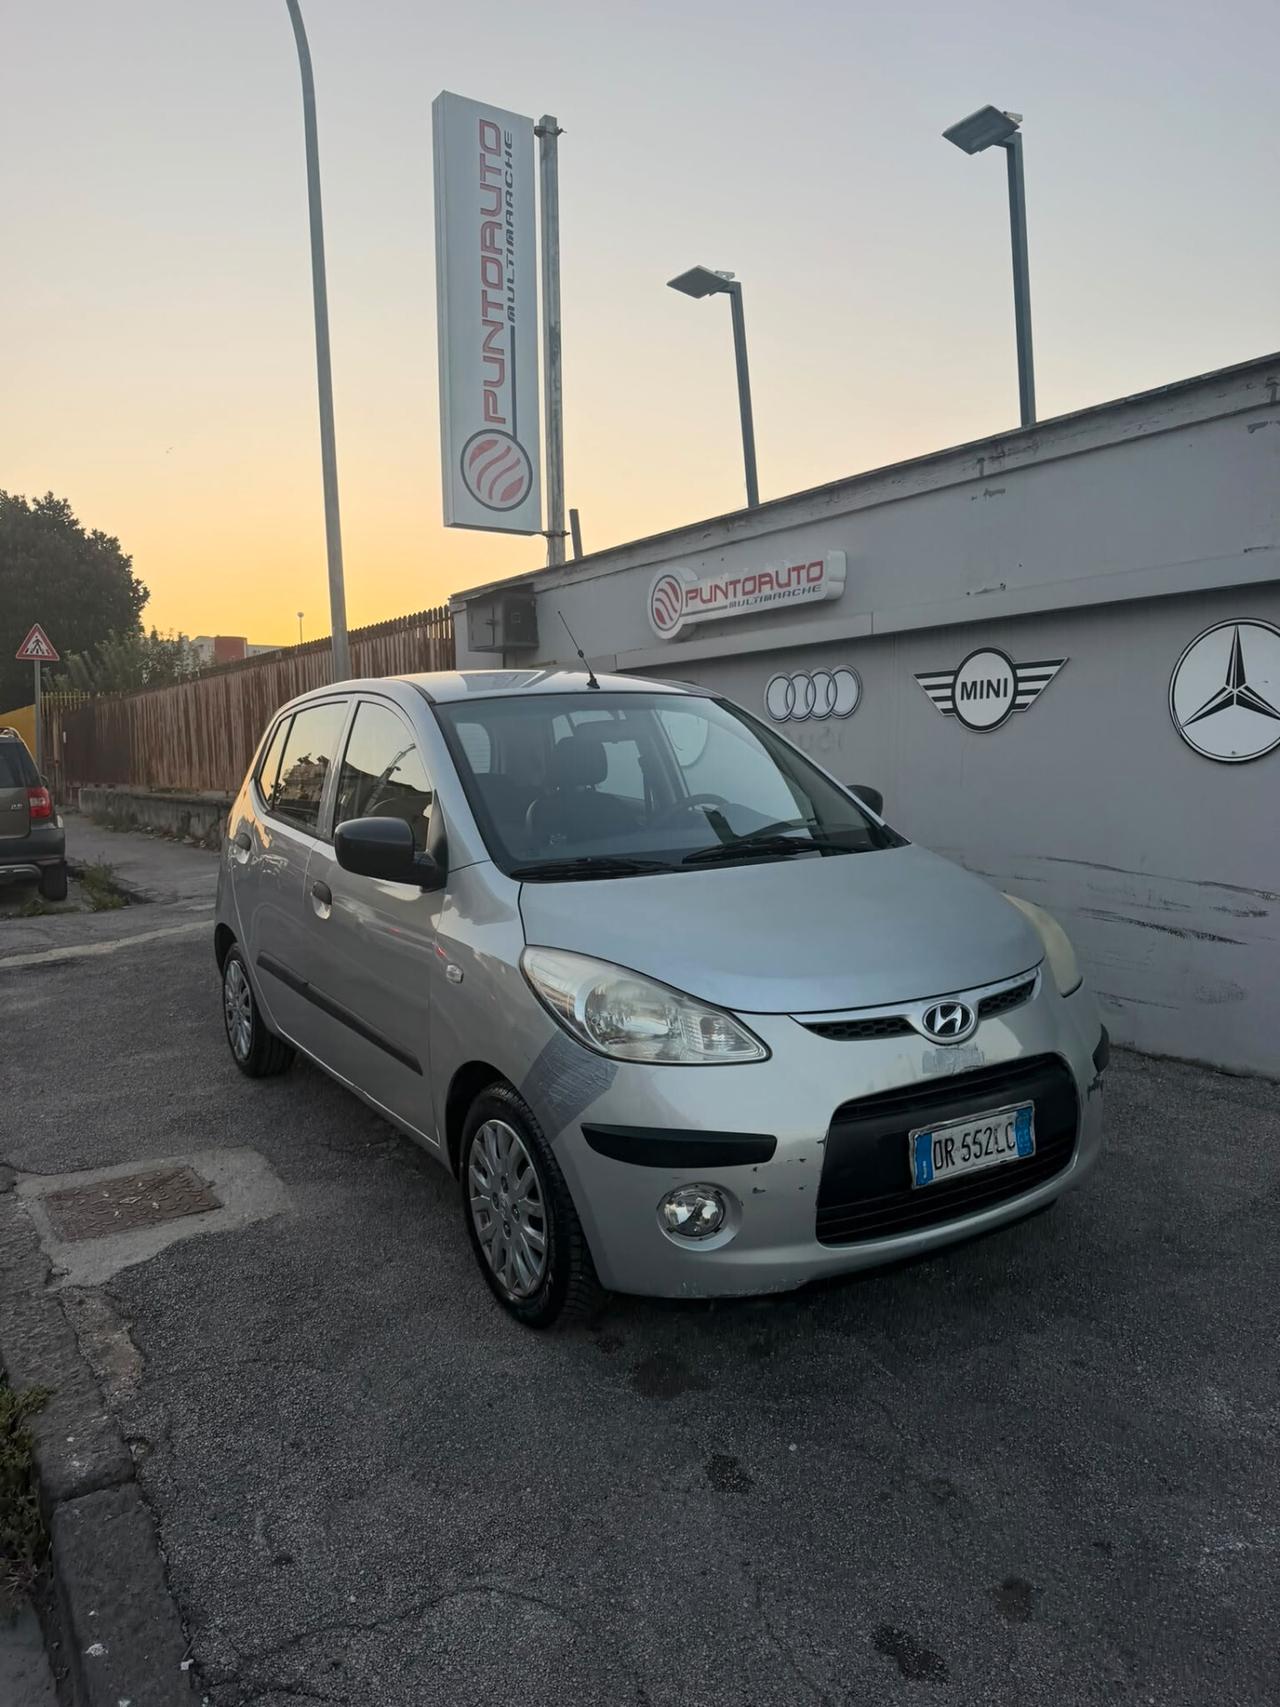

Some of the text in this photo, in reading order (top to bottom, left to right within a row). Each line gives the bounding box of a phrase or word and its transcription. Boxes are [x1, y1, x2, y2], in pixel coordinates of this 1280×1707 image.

[504, 130, 516, 323] MULTIMARCHE
[479, 118, 506, 425] PUNTOAUTO
[685, 560, 824, 608] PUNTOAUTO
[728, 584, 823, 609] MULTIMARCHE
[960, 677, 1009, 701] MINI
